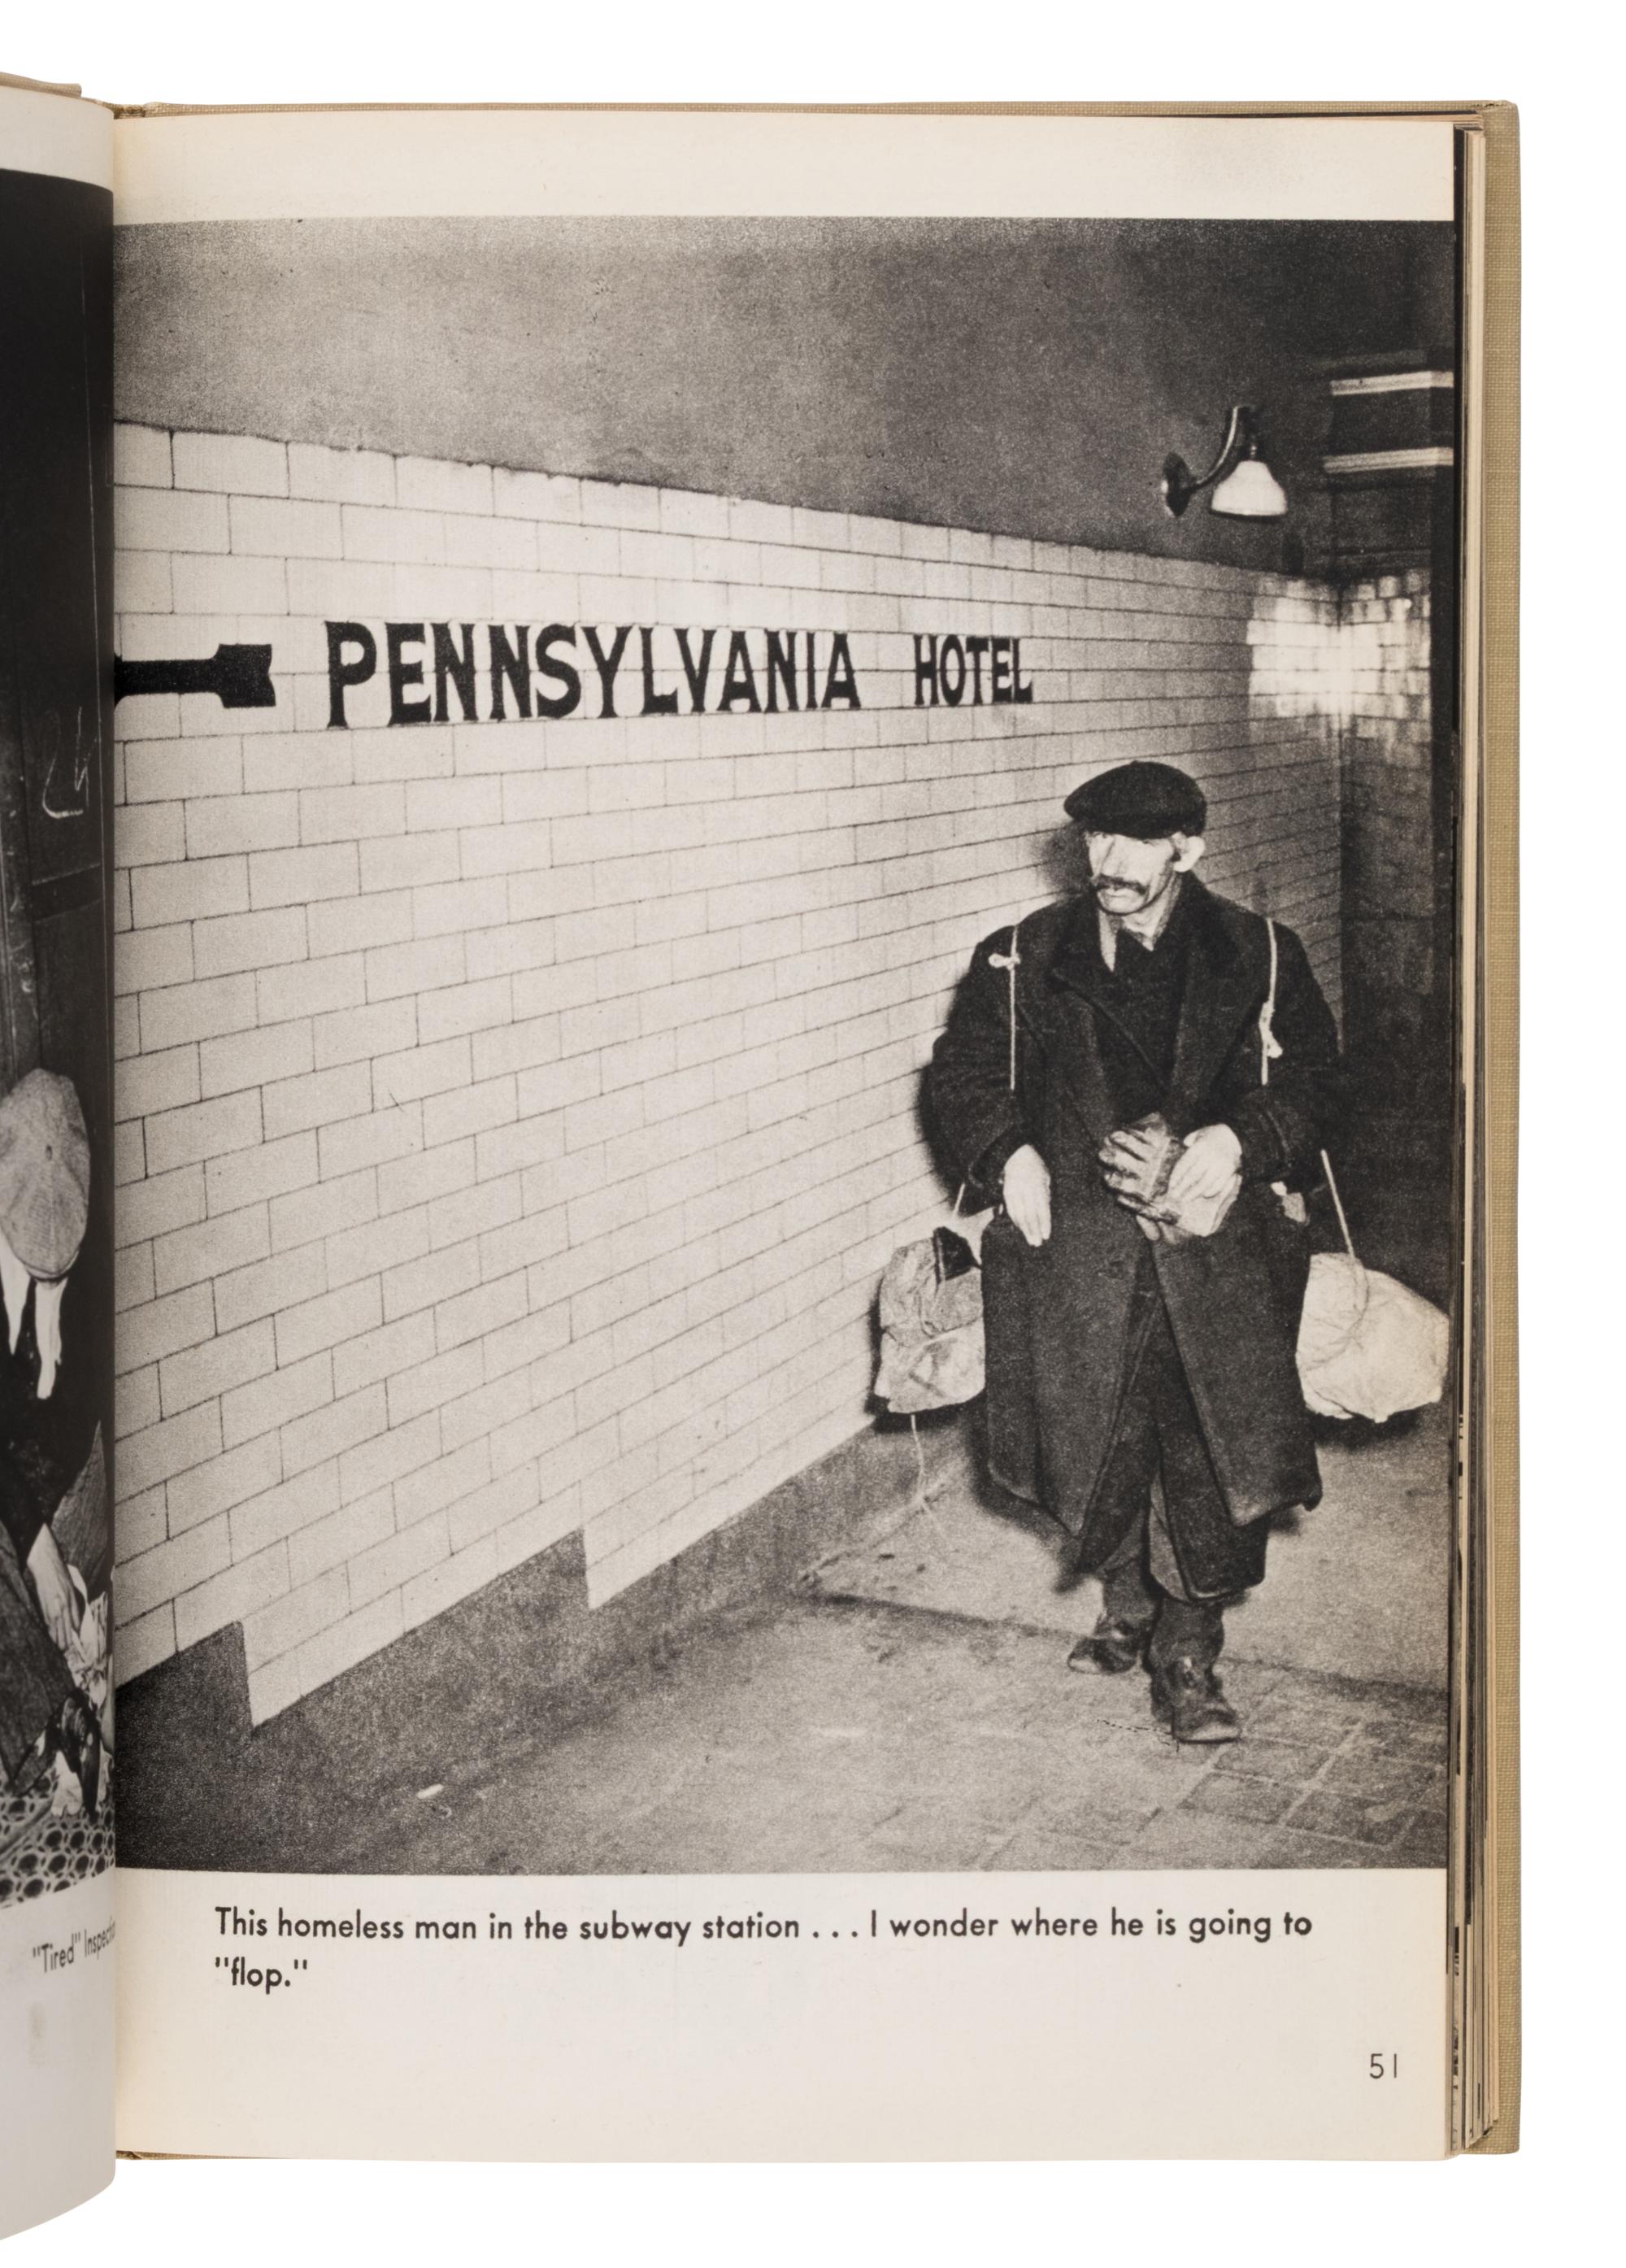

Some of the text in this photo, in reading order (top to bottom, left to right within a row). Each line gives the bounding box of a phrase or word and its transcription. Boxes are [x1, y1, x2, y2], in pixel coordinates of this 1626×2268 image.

[325, 620, 1033, 729] PENNSYLVANIA HOTEL
[215, 1905, 267, 1936] This
[278, 1907, 404, 1939] homeless
[415, 1921, 476, 1939] man
[489, 1912, 512, 1939] in
[524, 1909, 567, 1939] the
[580, 1909, 691, 1947] subway
[702, 1911, 799, 1939] station
[872, 1909, 876, 1937] I
[889, 1908, 998, 1937] wonder
[1011, 1907, 1098, 1936] where
[1111, 1906, 1144, 1936] he
[1156, 1909, 1176, 1935] is
[1189, 1908, 1271, 1944] going
[1284, 1912, 1312, 1936] to
[215, 1956, 307, 1995] "flop."
[1369, 2053, 1397, 2079] 51
